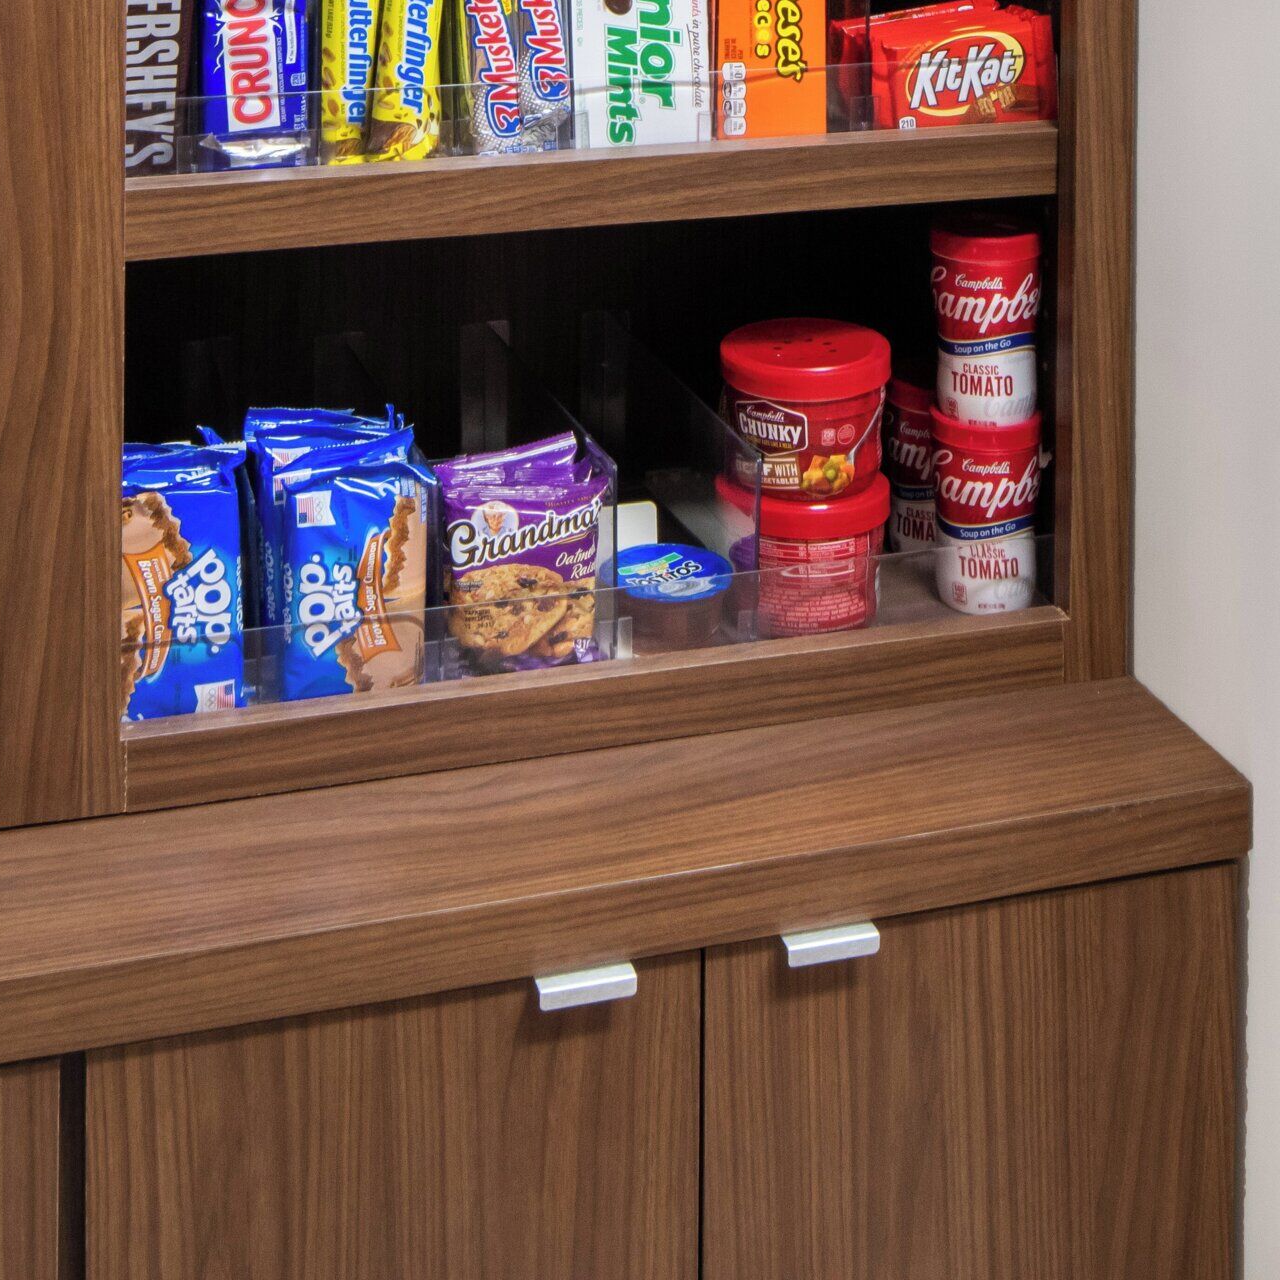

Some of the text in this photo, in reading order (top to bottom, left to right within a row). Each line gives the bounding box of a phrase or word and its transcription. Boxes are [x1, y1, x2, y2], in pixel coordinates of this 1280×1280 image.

[692, 18, 701, 30] in
[688, 30, 701, 57] pure
[606, 26, 641, 144] Mints
[900, 118, 915, 129] 210
[955, 273, 1004, 293] Campbell's
[954, 338, 1012, 355] Soup on the Go
[962, 362, 1000, 376] CLASSIC
[951, 371, 1014, 397] TOMATO
[746, 404, 785, 423] Campbell's
[739, 412, 803, 445] CHUNKY
[774, 463, 798, 477] WITH
[961, 458, 1011, 477] Campbell's
[960, 523, 1017, 539] Soup on the Go
[363, 540, 378, 612] Sugar Cinnamon
[958, 555, 1020, 581] TOMATO
[138, 559, 162, 626] Brown Sugar
[332, 563, 361, 635] tarts
[166, 573, 198, 645] tarts
